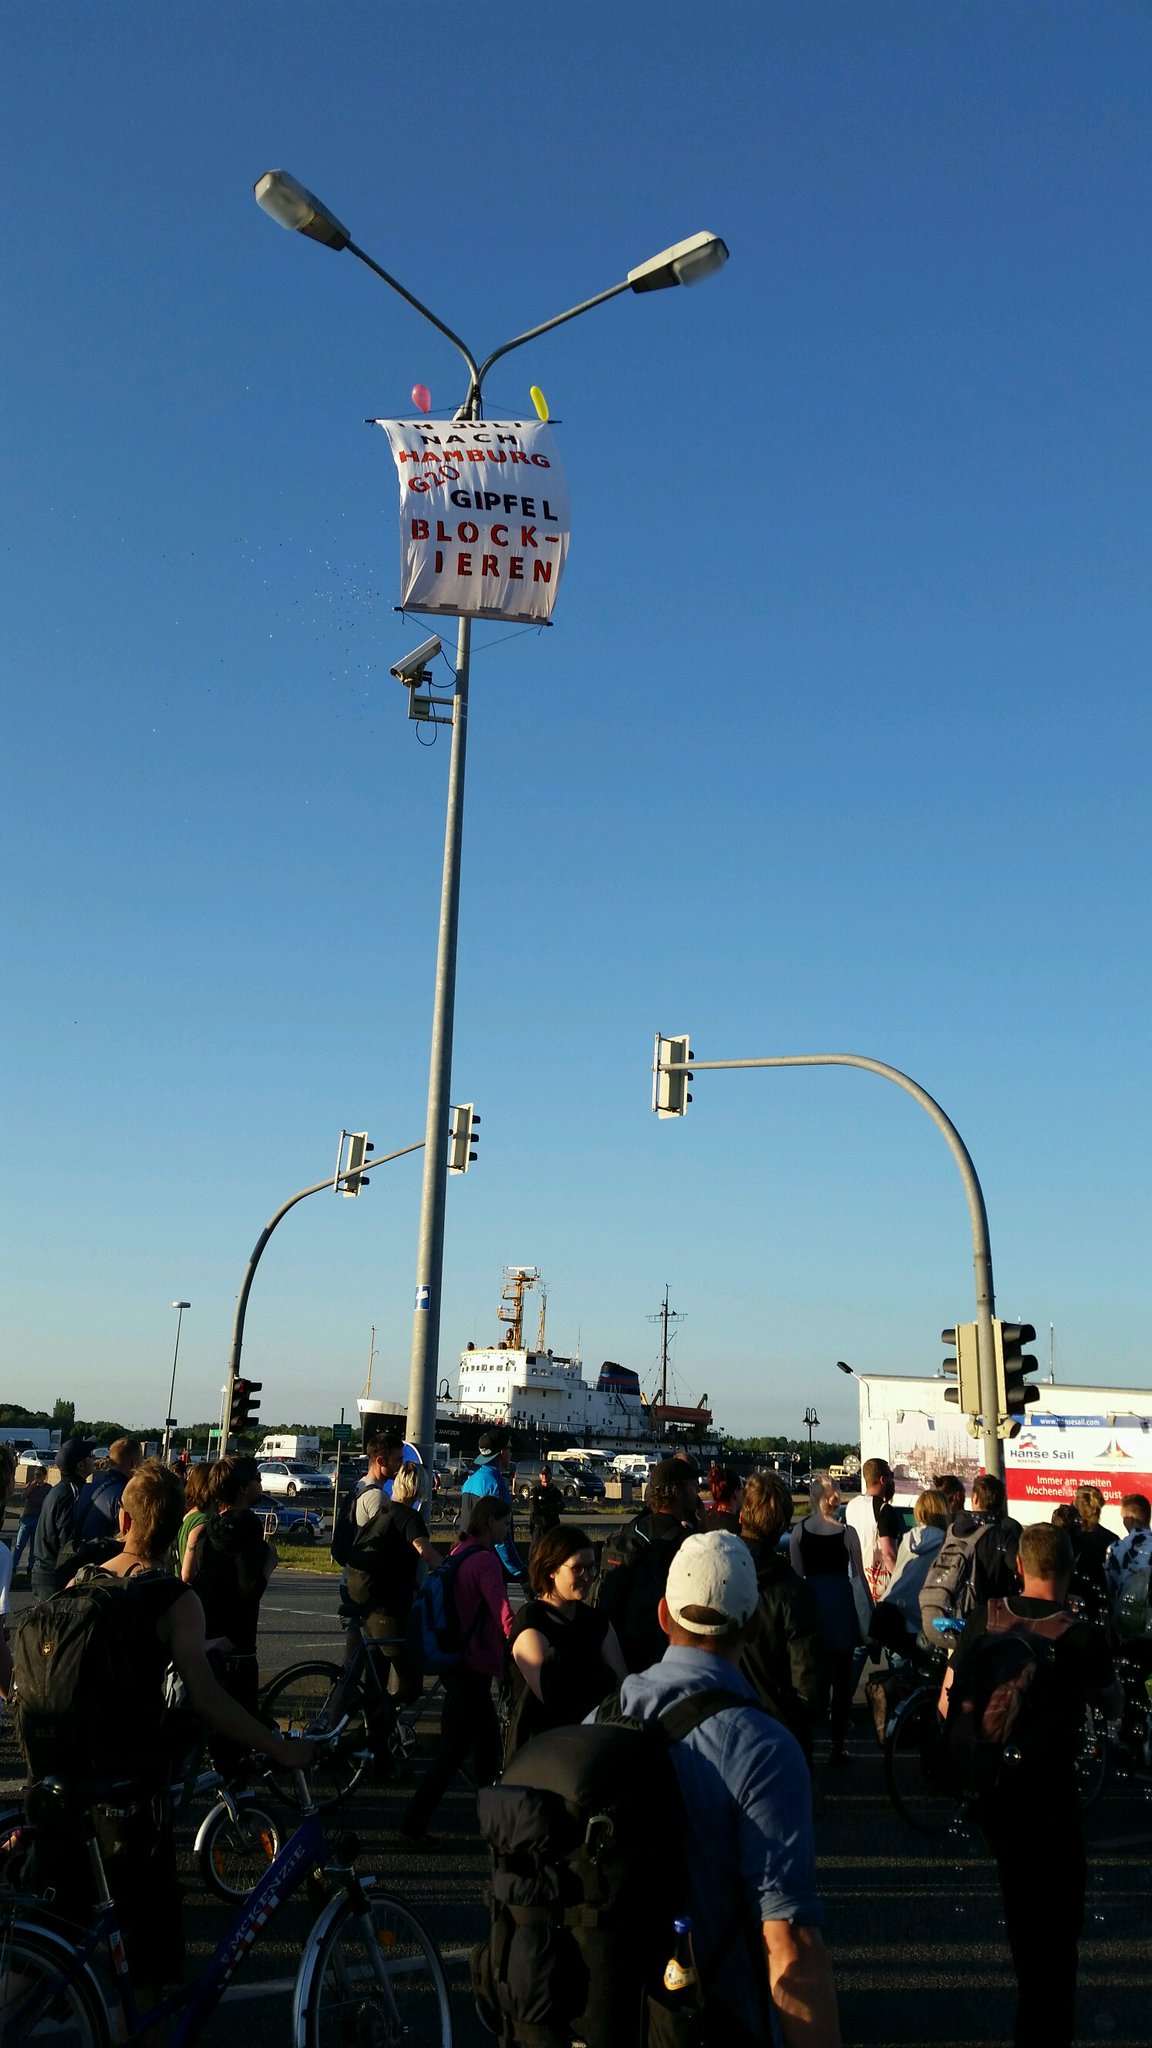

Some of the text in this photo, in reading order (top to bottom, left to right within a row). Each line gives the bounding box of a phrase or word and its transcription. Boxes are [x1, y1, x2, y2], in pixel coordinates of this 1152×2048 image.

[397, 422, 523, 430] IM JULI
[420, 433, 518, 445] NACH
[399, 449, 551, 468] HAMBURG
[408, 465, 460, 493] G20
[450, 489, 558, 522] GIPFEL
[411, 518, 559, 548] BLOCK-
[434, 550, 552, 583] IEREN
[1010, 1450, 1074, 1459] Hanse Sail
[1037, 1475, 1063, 1486] Immer
[1079, 1478, 1112, 1487] zweiten
